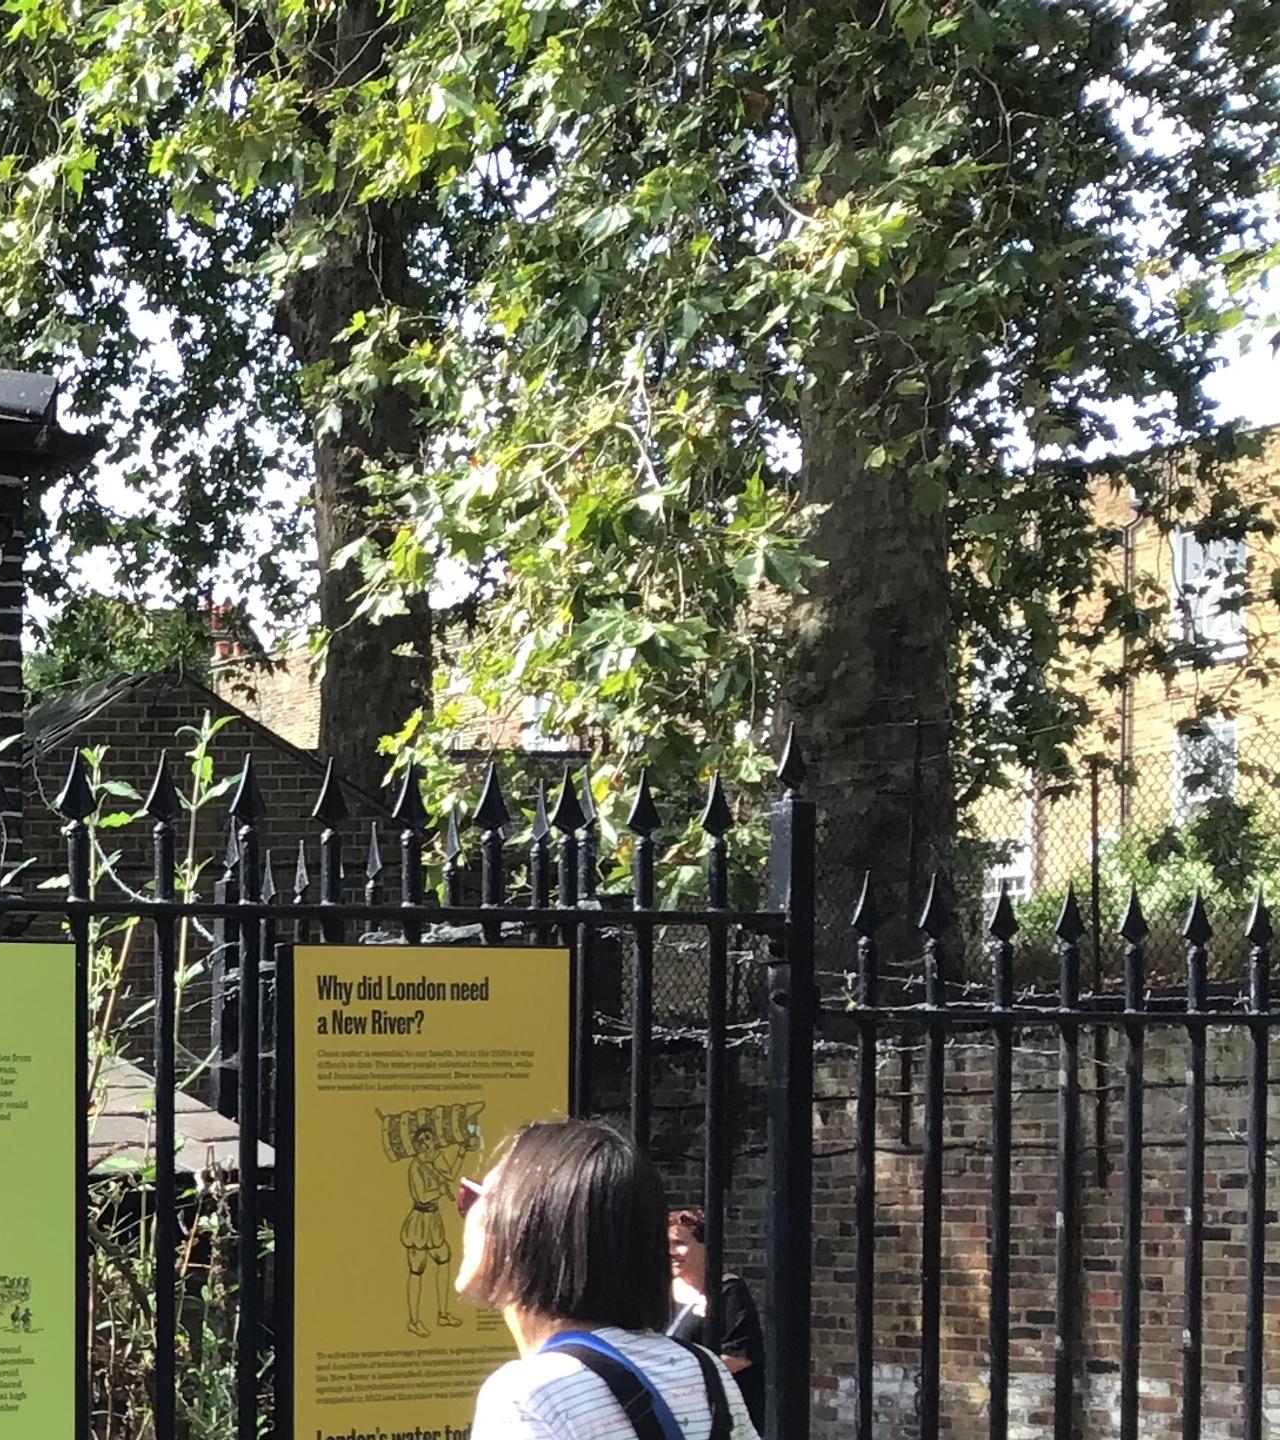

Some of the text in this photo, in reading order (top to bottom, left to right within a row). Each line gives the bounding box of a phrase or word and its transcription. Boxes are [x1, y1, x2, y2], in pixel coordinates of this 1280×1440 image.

[317, 975, 490, 1004] Why did London need
[317, 1009, 425, 1034] a New River?
